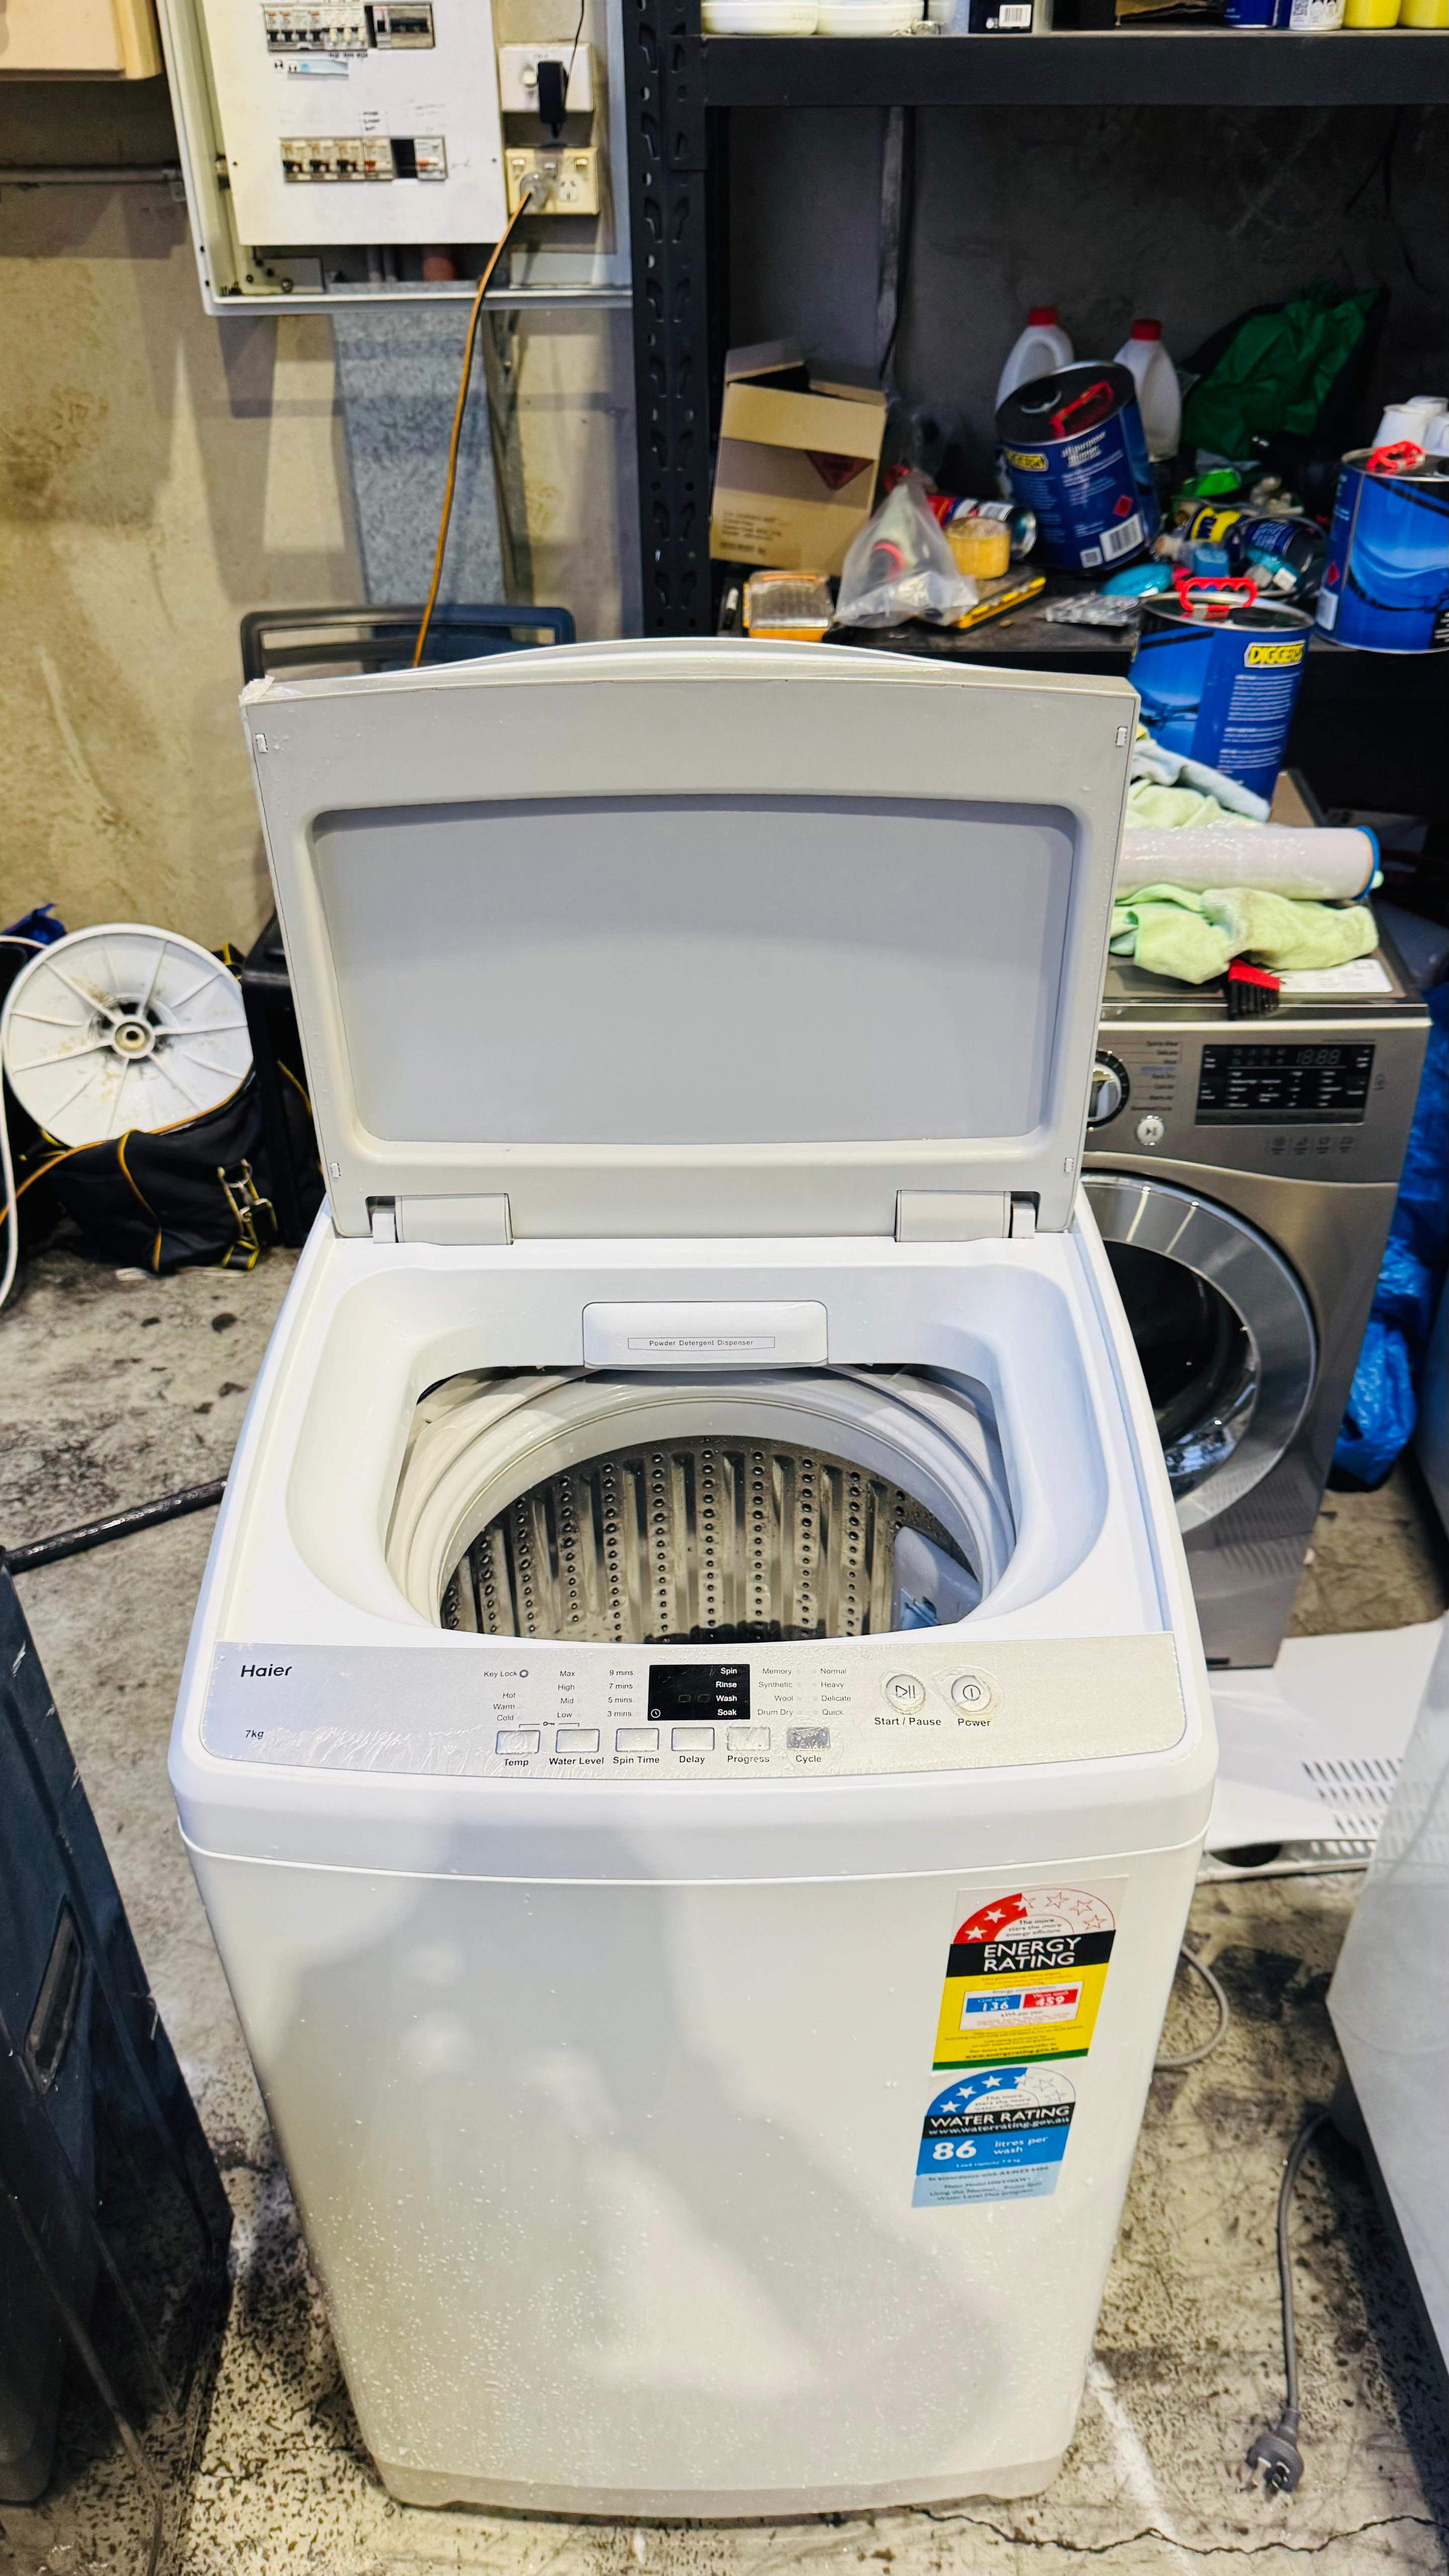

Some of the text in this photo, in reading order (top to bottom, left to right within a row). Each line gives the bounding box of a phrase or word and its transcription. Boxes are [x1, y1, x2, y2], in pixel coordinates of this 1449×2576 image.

[240, 1664, 292, 1677] Haier
[558, 1683, 575, 1692] High
[874, 1717, 900, 1726] Start
[909, 1718, 941, 1726] Pause
[958, 1718, 991, 1727] Power
[245, 1729, 264, 1740] 7kg
[504, 1758, 529, 1767] Temp
[613, 1756, 634, 1764] Spin
[679, 1756, 705, 1764] Delay
[727, 1755, 770, 1764] Progress
[795, 1755, 821, 1763] Cycle
[984, 1937, 1082, 1958] ENERGY
[984, 1952, 1076, 1972] RATING
[1035, 1995, 1065, 2006] 459
[983, 2001, 1009, 2011] 136
[930, 2105, 1070, 2128] WATER RATING
[933, 2136, 1049, 2160] 86 litres per
[993, 2146, 1023, 2155] wash
